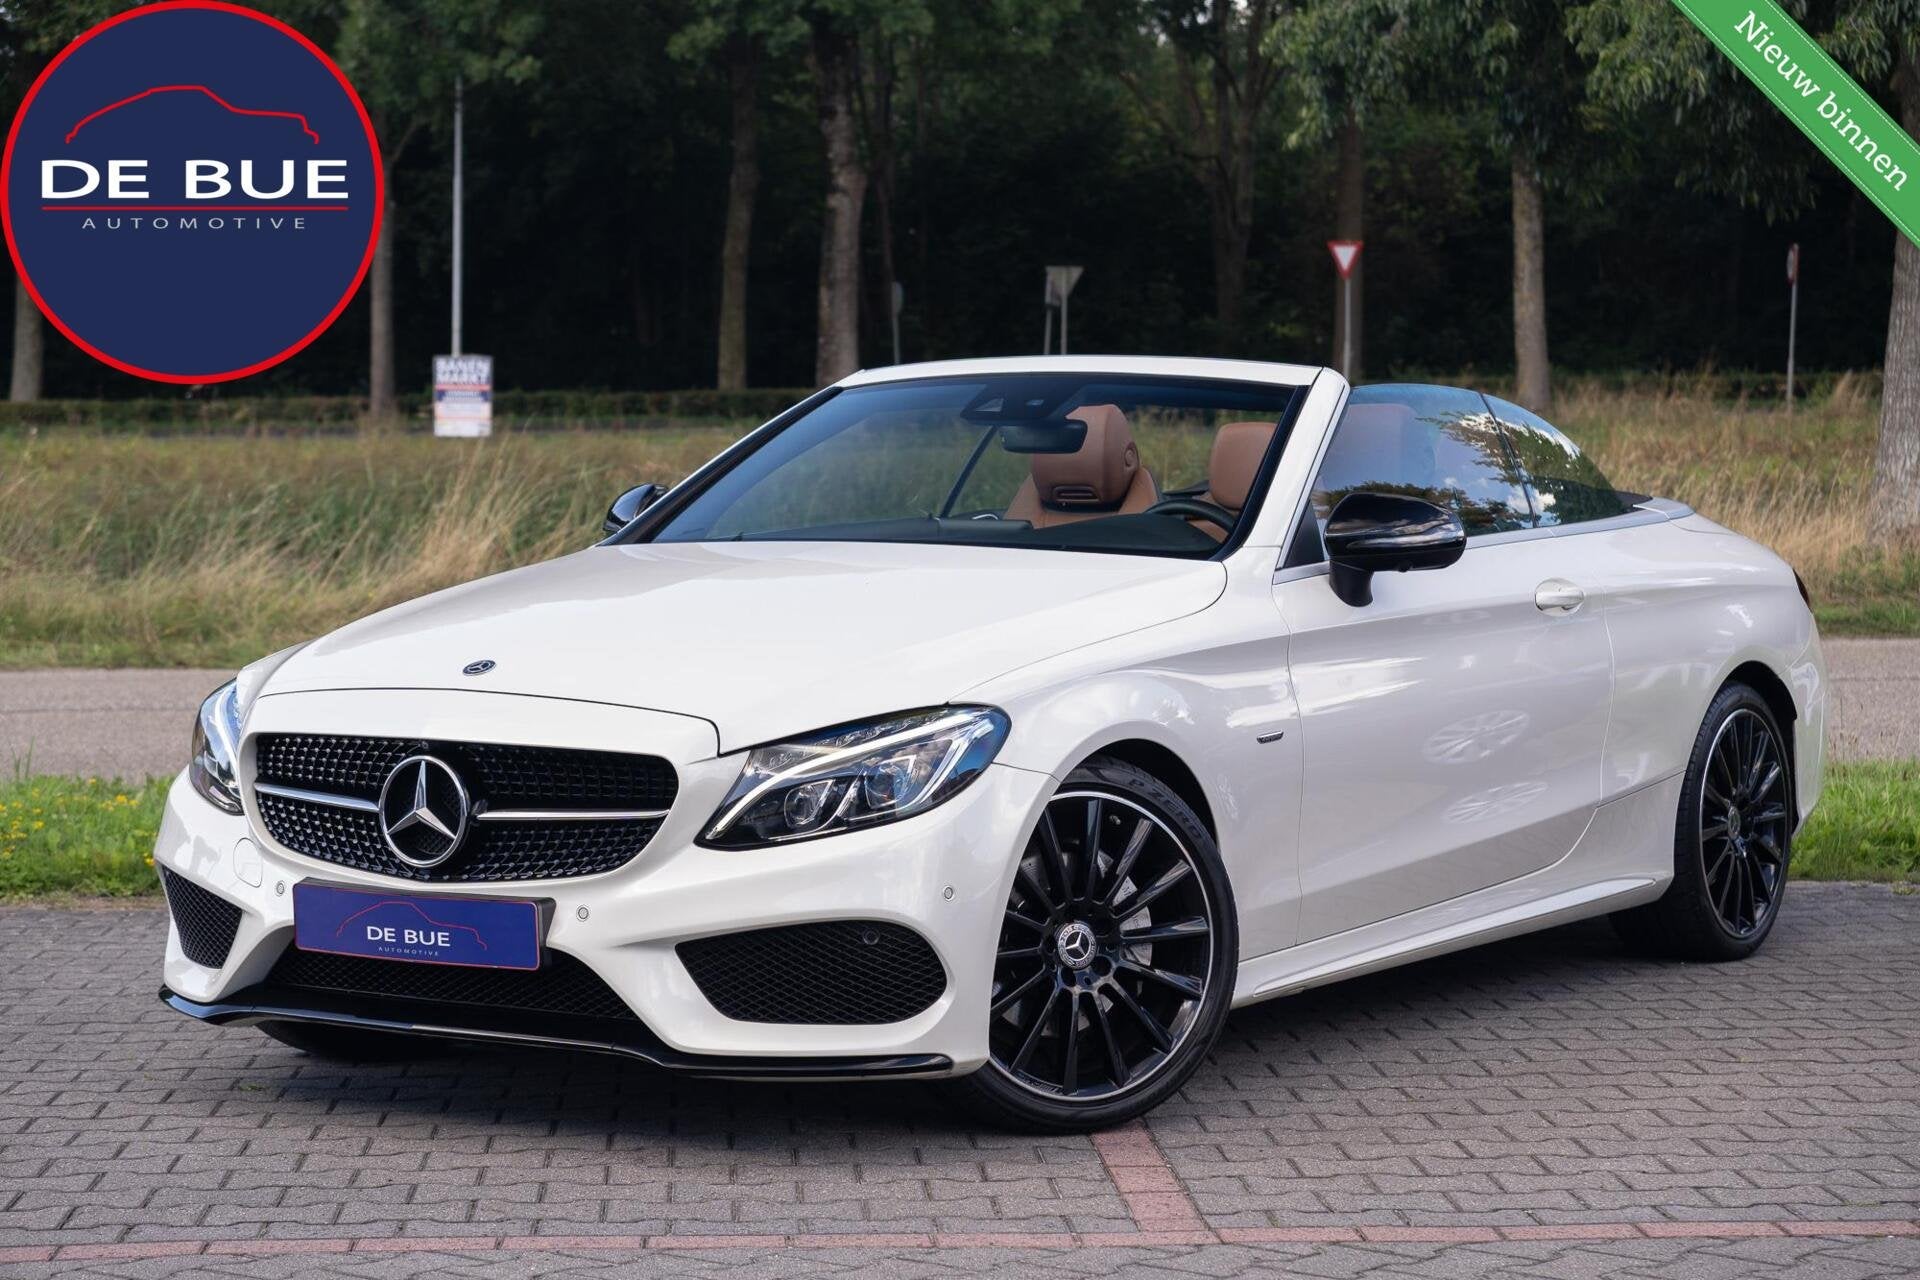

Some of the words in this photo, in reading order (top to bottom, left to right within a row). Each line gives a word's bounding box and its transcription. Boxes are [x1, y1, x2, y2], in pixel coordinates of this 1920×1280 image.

[366, 926, 396, 942] DE
[404, 929, 450, 947] BUE
[379, 946, 439, 956] AUTOMOTIVE
